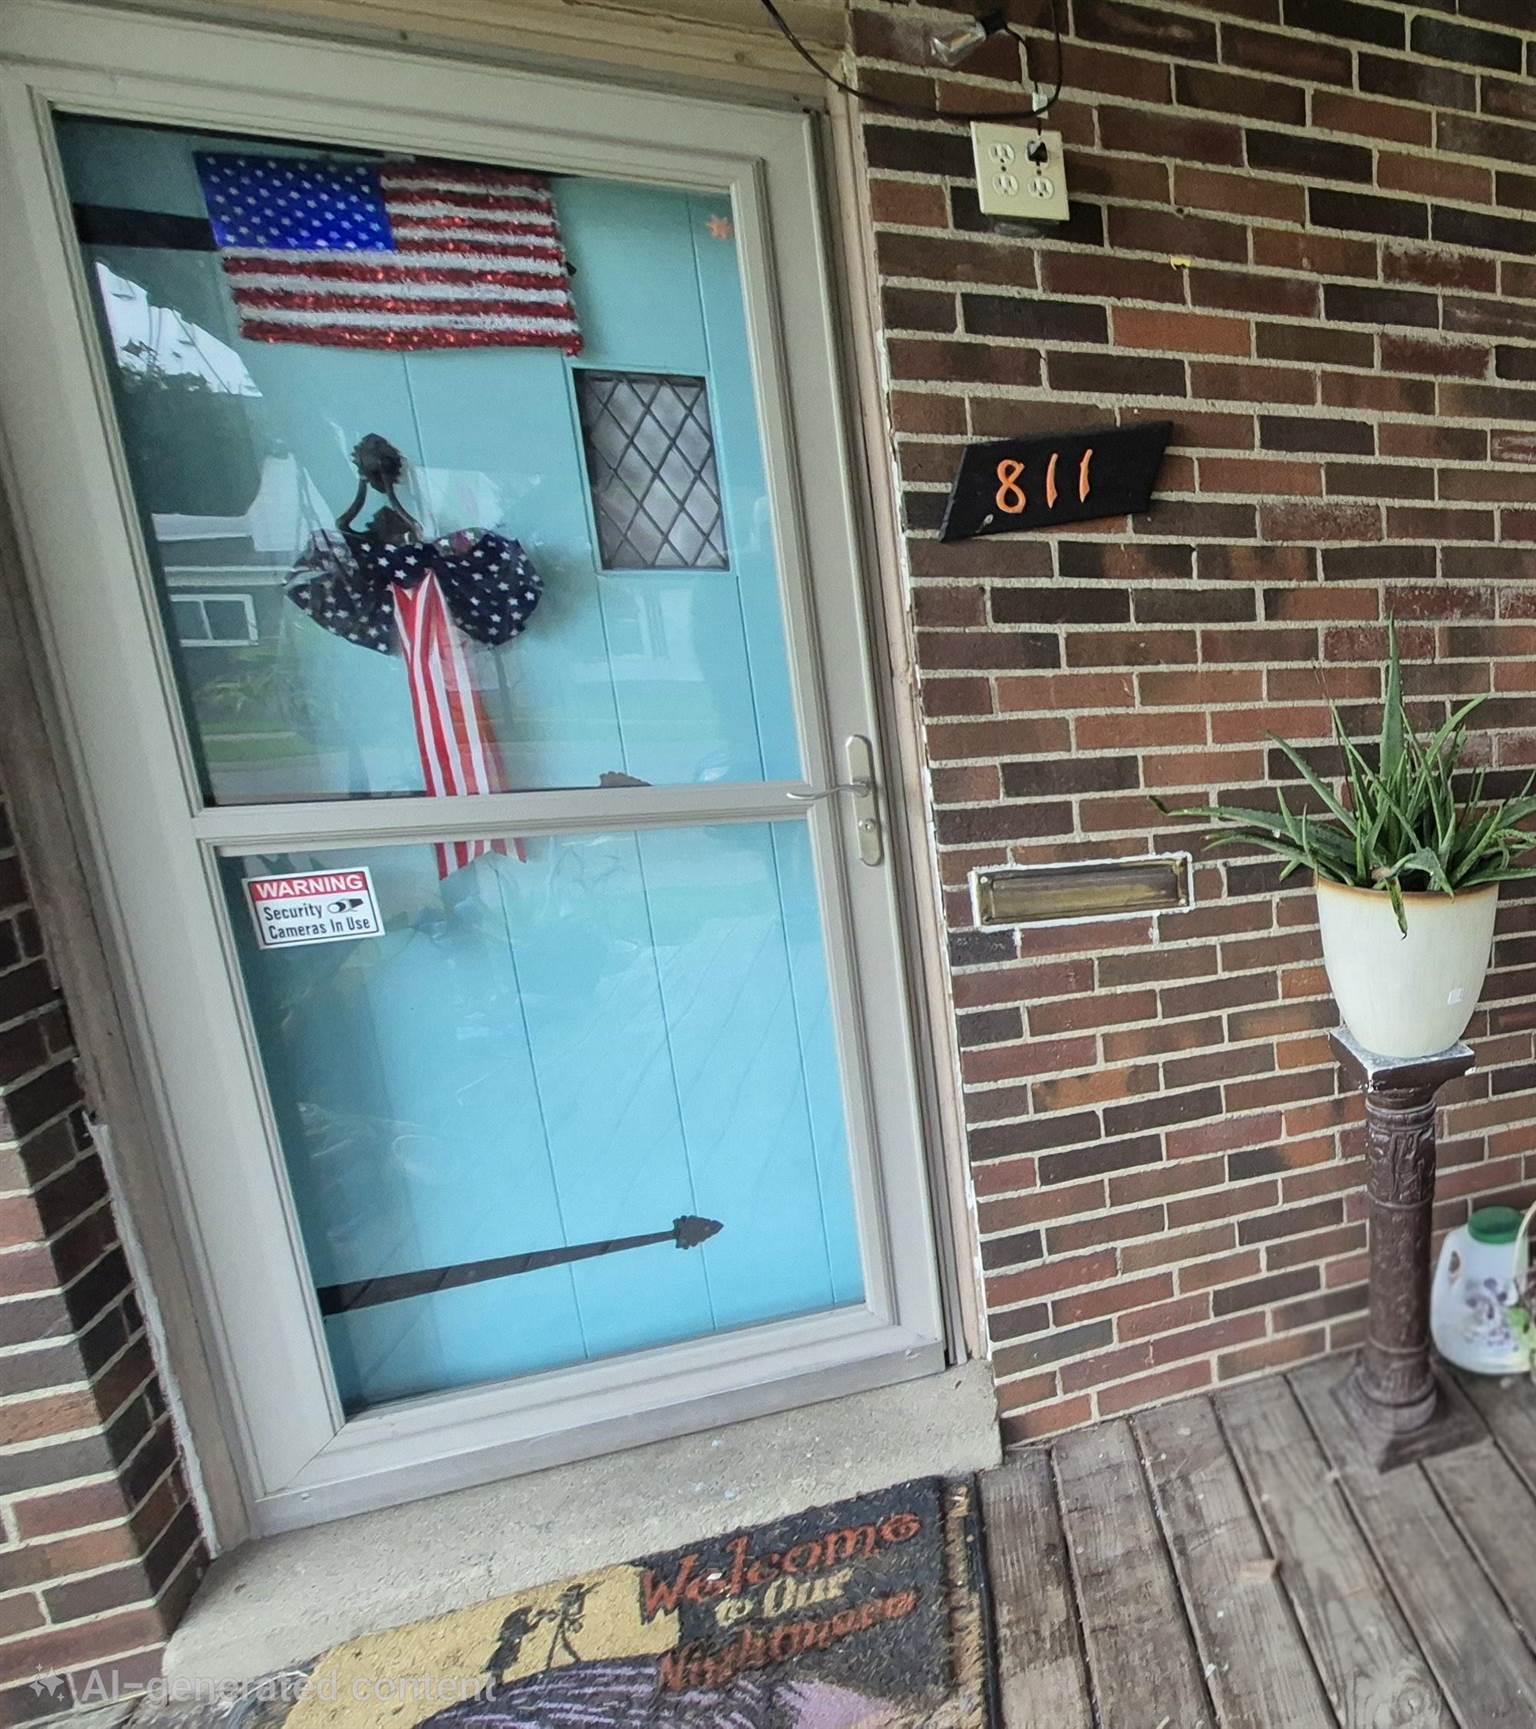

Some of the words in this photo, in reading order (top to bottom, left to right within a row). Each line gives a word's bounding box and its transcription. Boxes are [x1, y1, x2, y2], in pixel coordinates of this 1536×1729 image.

[996, 449, 1094, 514] 811
[256, 875, 363, 898] WARNING
[263, 903, 322, 921] Security
[268, 923, 327, 939] Cameras
[331, 919, 343, 932] In
[347, 916, 370, 930] Use
[641, 1513, 922, 1623] Welcome
[763, 1568, 854, 1617] Our
